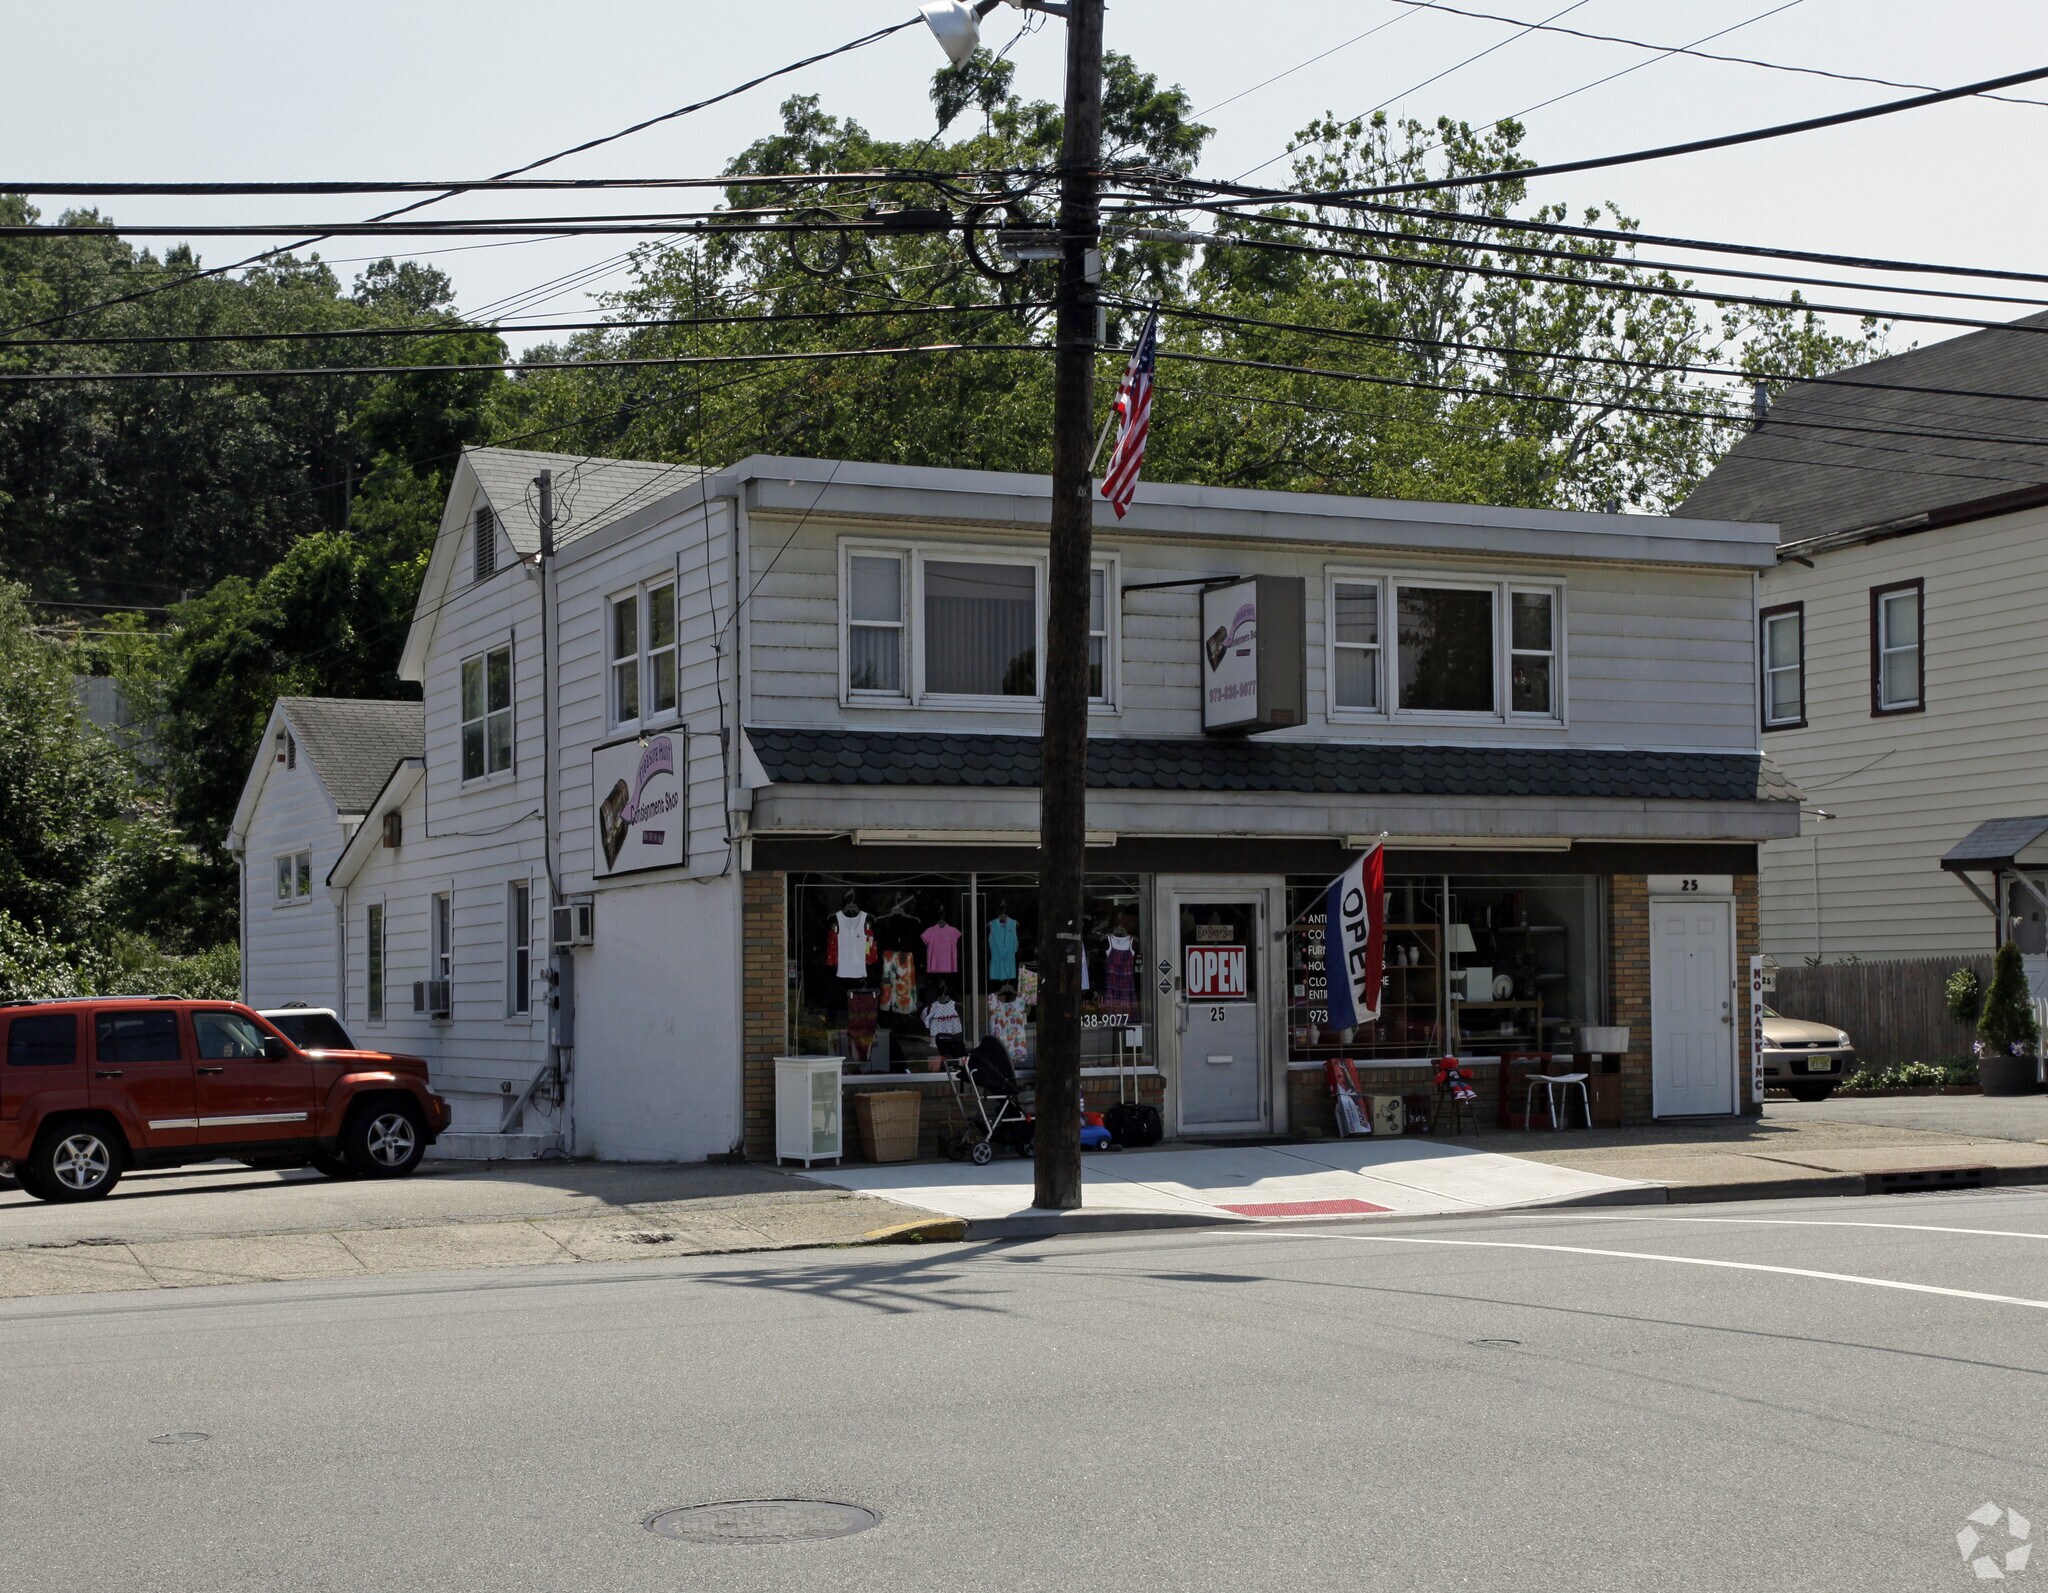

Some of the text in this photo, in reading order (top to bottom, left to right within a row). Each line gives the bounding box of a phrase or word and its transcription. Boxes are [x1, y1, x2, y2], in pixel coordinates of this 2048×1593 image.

[1681, 879, 1698, 891] 25
[1308, 914, 1327, 924] ANTI
[1308, 929, 1326, 940] COL
[1308, 961, 1326, 971] HOU
[1189, 951, 1244, 993] OPEN
[1308, 977, 1327, 987] CLO
[1308, 989, 1328, 1000] ENTI
[1211, 1007, 1225, 1021] 25
